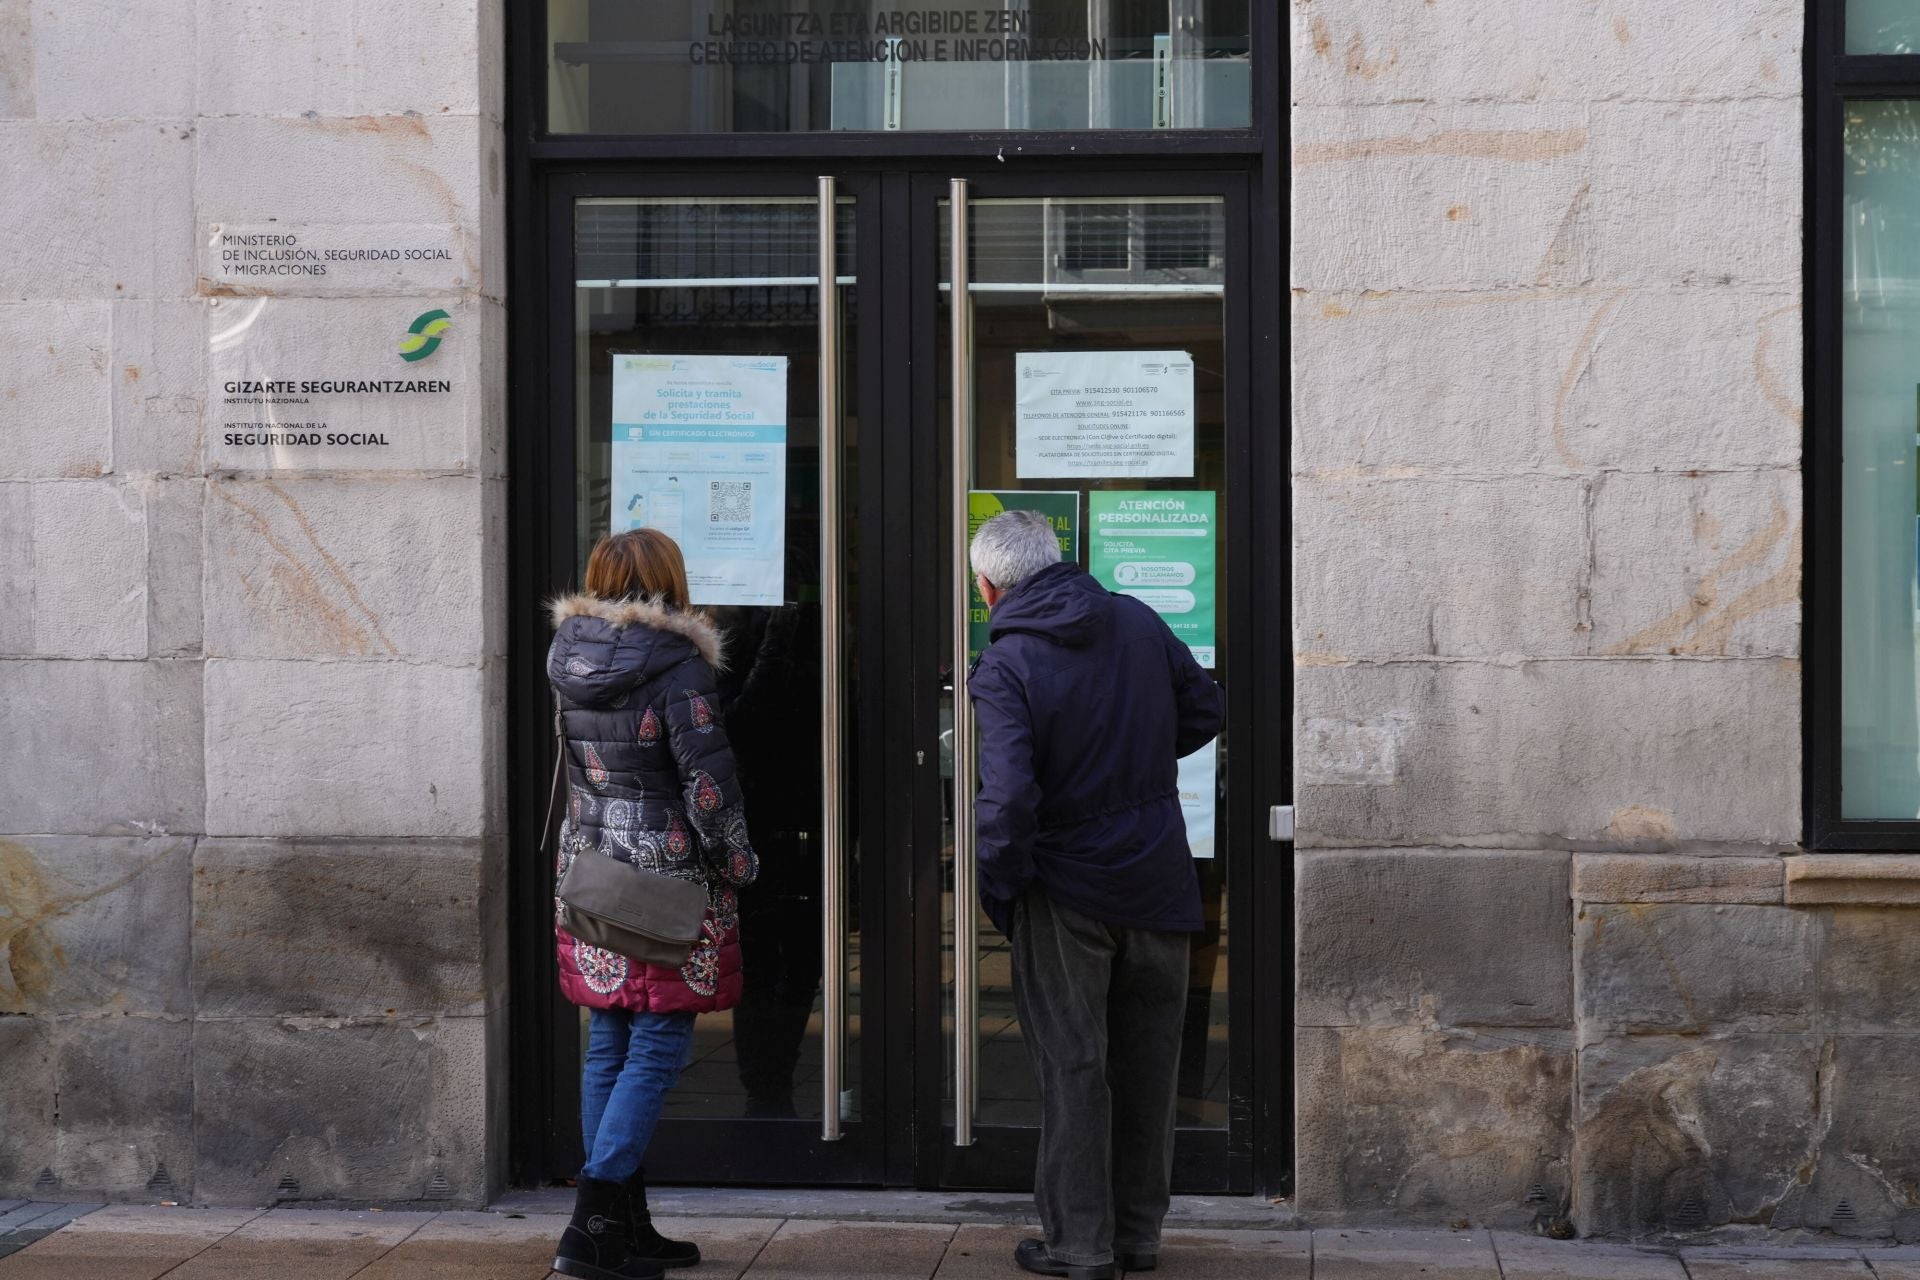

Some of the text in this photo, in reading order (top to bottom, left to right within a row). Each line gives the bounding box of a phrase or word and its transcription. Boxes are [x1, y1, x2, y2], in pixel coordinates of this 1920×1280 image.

[708, 13, 823, 36] LAGUNTZA
[829, 12, 871, 35] ETA
[875, 11, 977, 35] ARGIBIDE
[689, 41, 781, 65] CENTRO
[785, 40, 817, 63] DE
[935, 39, 948, 62] E
[222, 235, 297, 246] MINISTERIO
[222, 247, 452, 262] DE INCLUSIÓN, SEGURIDAD SOCIAL
[222, 264, 327, 276] Y MIGRACIONES
[224, 381, 451, 394] GIZARTE SEGURANTZAREN
[656, 388, 742, 402] Solicita y tramita
[668, 400, 731, 411] prestaciones
[644, 411, 755, 422] de la Seguridad Social
[224, 433, 390, 446] SEGURIDAD SOCIAL
[649, 430, 660, 438] SIN
[662, 430, 706, 438] CERTIFICADO
[1118, 498, 1185, 510] ATENCIÓN
[1098, 512, 1209, 524] PERSONALIZADA
